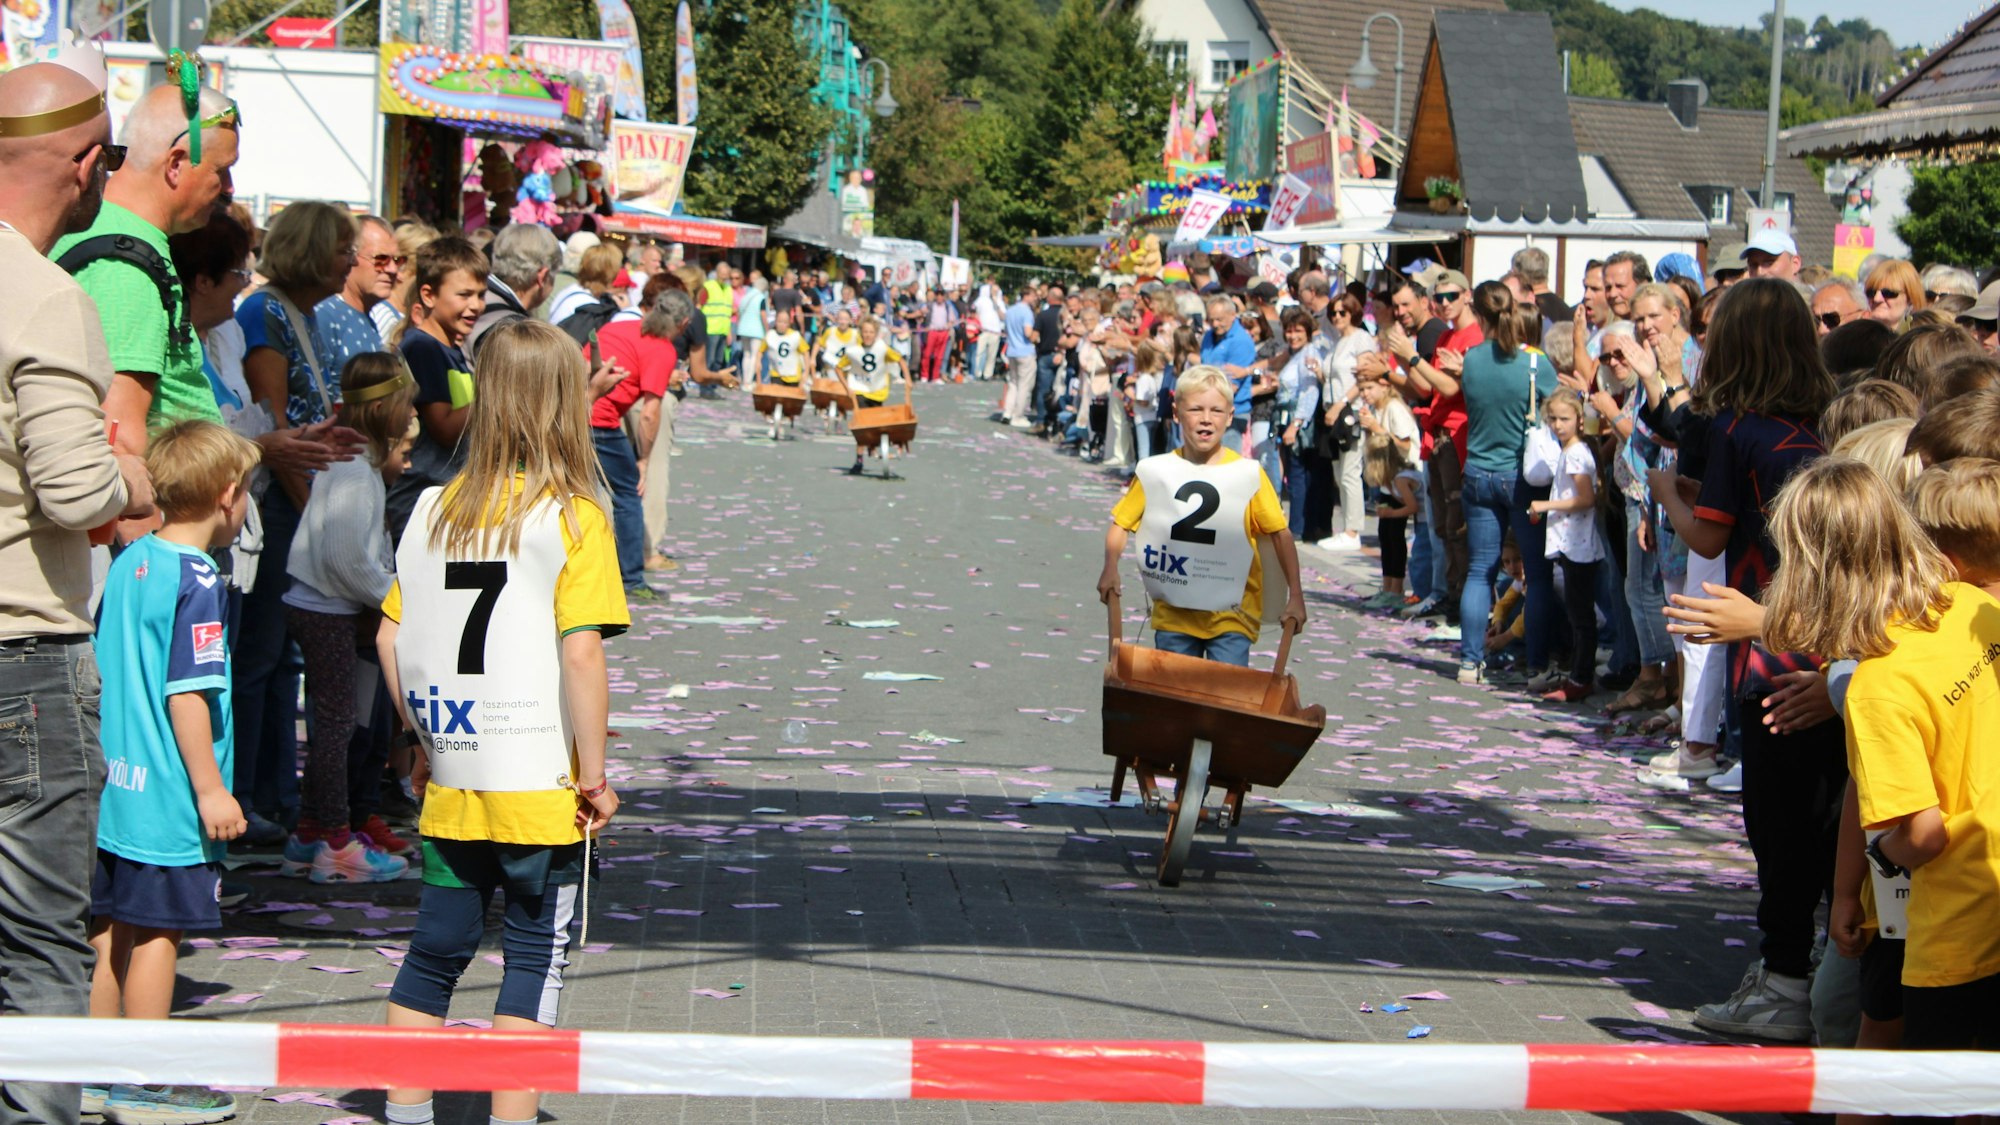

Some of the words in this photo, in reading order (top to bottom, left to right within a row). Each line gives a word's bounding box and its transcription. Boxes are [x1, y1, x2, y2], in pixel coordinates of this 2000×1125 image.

[618, 132, 685, 166] PASTA
[1183, 201, 1219, 230] EIS
[1271, 187, 1300, 226] EIS
[778, 341, 789, 358] 6
[836, 346, 846, 358] 4
[862, 353, 876, 372] 8
[1170, 480, 1220, 545] 2
[1144, 544, 1189, 576] tix
[445, 561, 508, 674] 7
[1943, 680, 1971, 706] Ich
[1967, 661, 1983, 684] war
[407, 686, 477, 735] tix
[482, 700, 540, 709] faszination
[482, 713, 510, 722] home
[483, 724, 558, 735] entertainment
[107, 756, 147, 792] KÖLN
